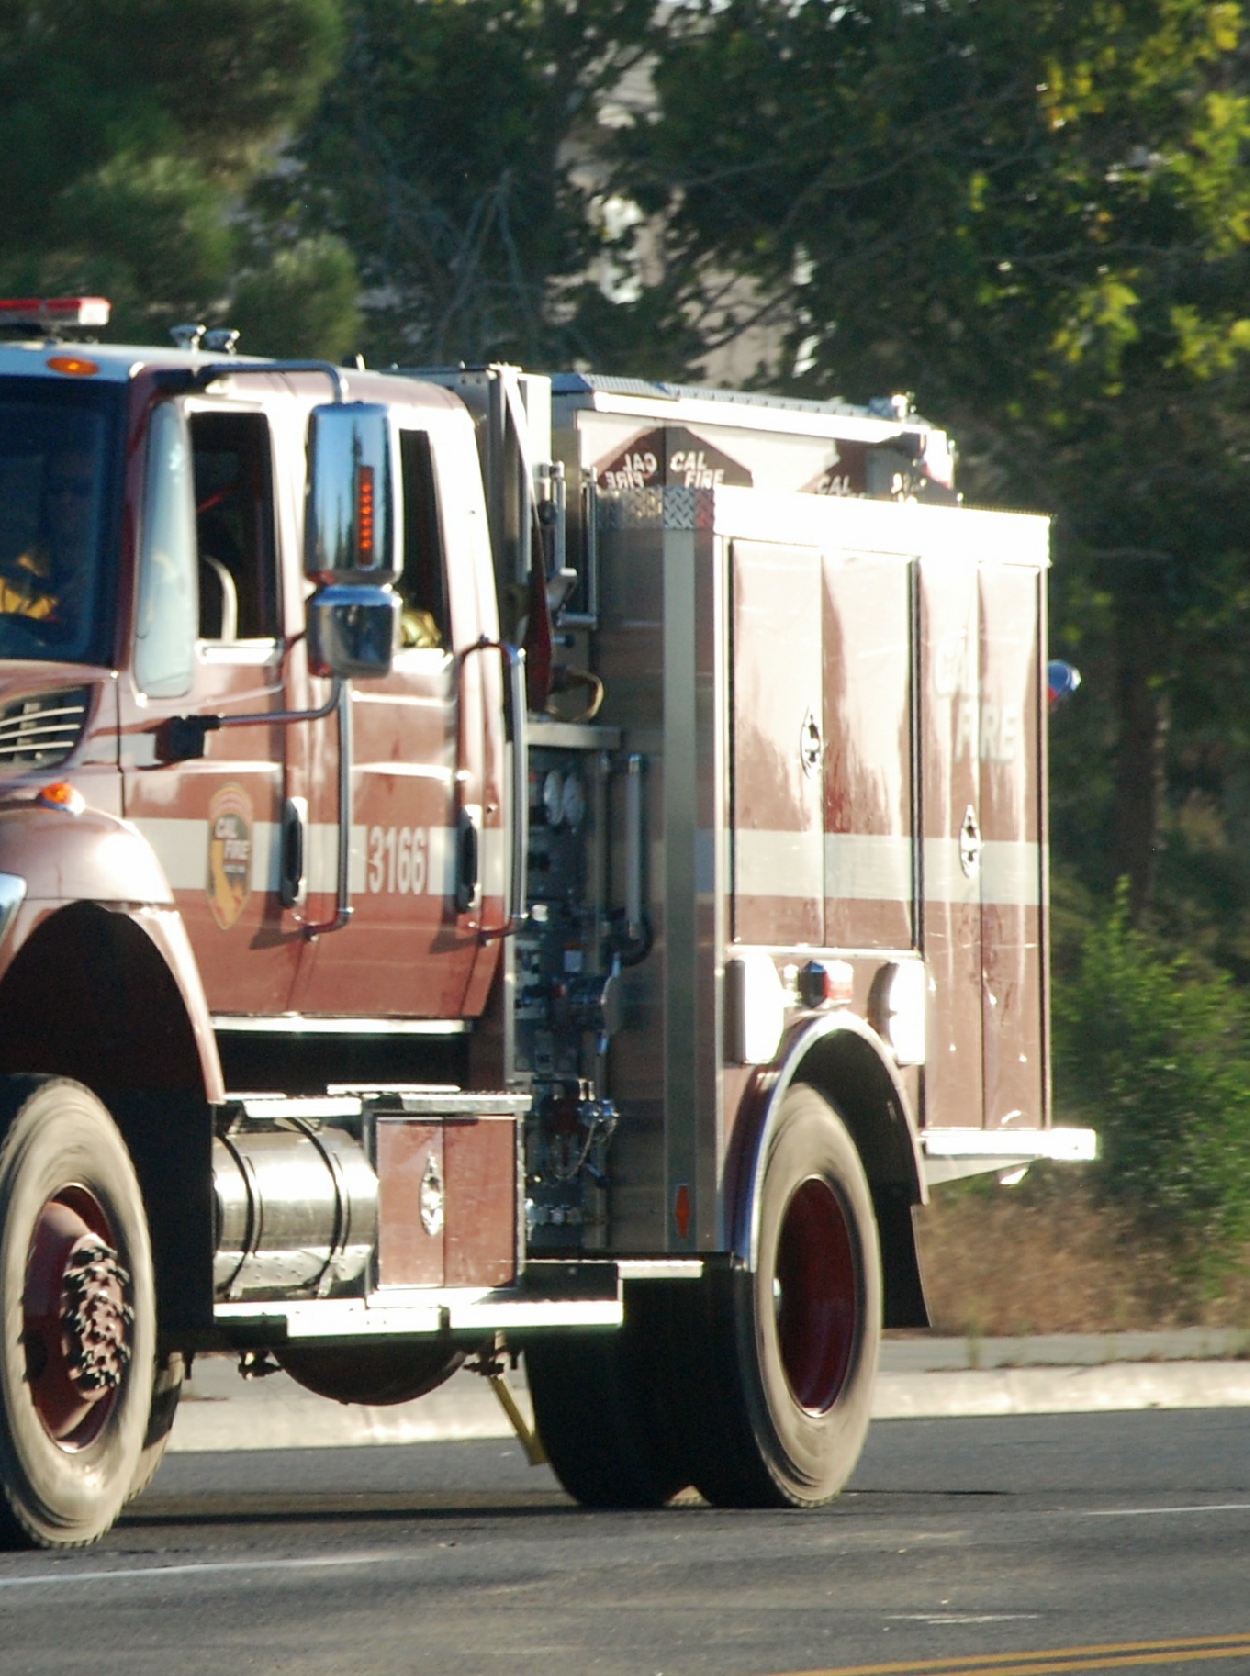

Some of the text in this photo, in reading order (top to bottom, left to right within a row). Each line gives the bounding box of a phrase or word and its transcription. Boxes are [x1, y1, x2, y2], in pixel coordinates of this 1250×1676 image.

[670, 450, 708, 473] CAL
[684, 468, 725, 490] FIRE
[817, 474, 852, 496] CAL
[369, 826, 426, 894] 3166
